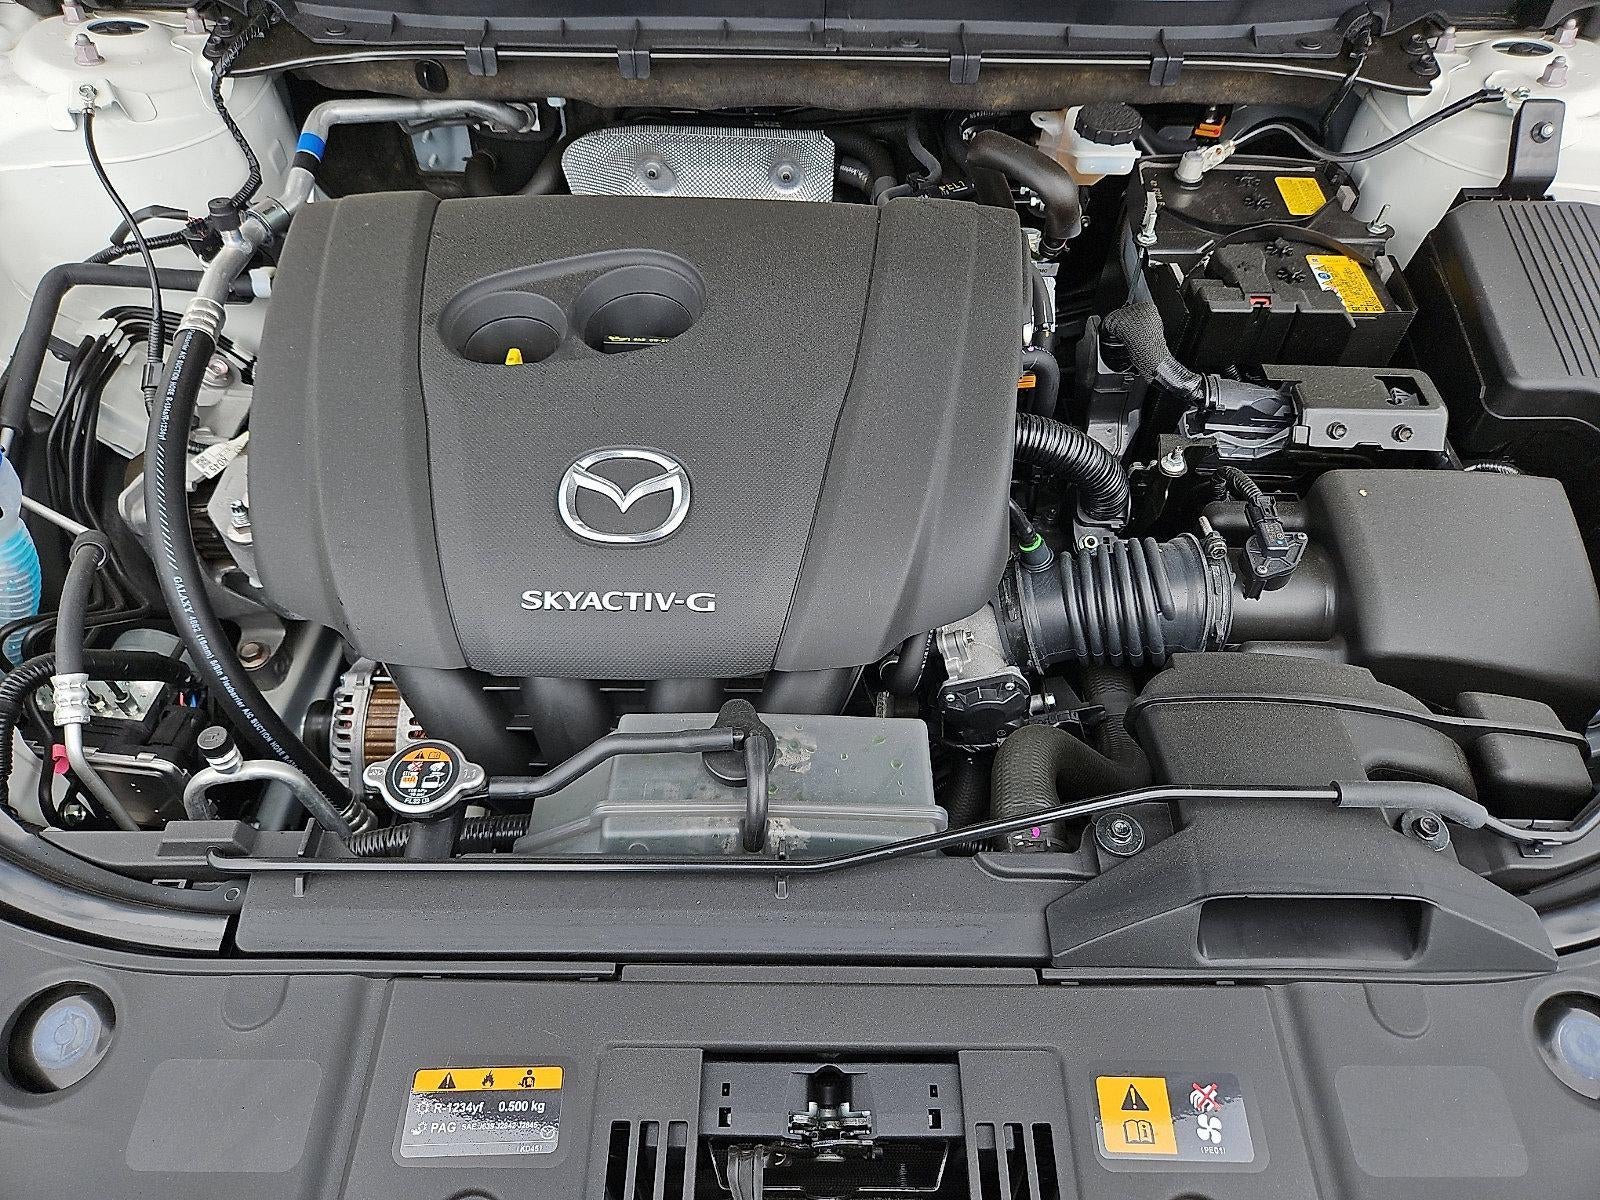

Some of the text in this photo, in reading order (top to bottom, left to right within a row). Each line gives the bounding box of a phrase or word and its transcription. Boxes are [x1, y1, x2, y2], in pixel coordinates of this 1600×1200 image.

[520, 590, 716, 612] SKYACTIV-G
[173, 575, 195, 614] GALAXY
[250, 717, 274, 743] SUCTION
[269, 740, 286, 756] HOSE
[433, 1101, 546, 1115] R-1234yf 0.500 kg
[430, 1122, 457, 1134] PAG
